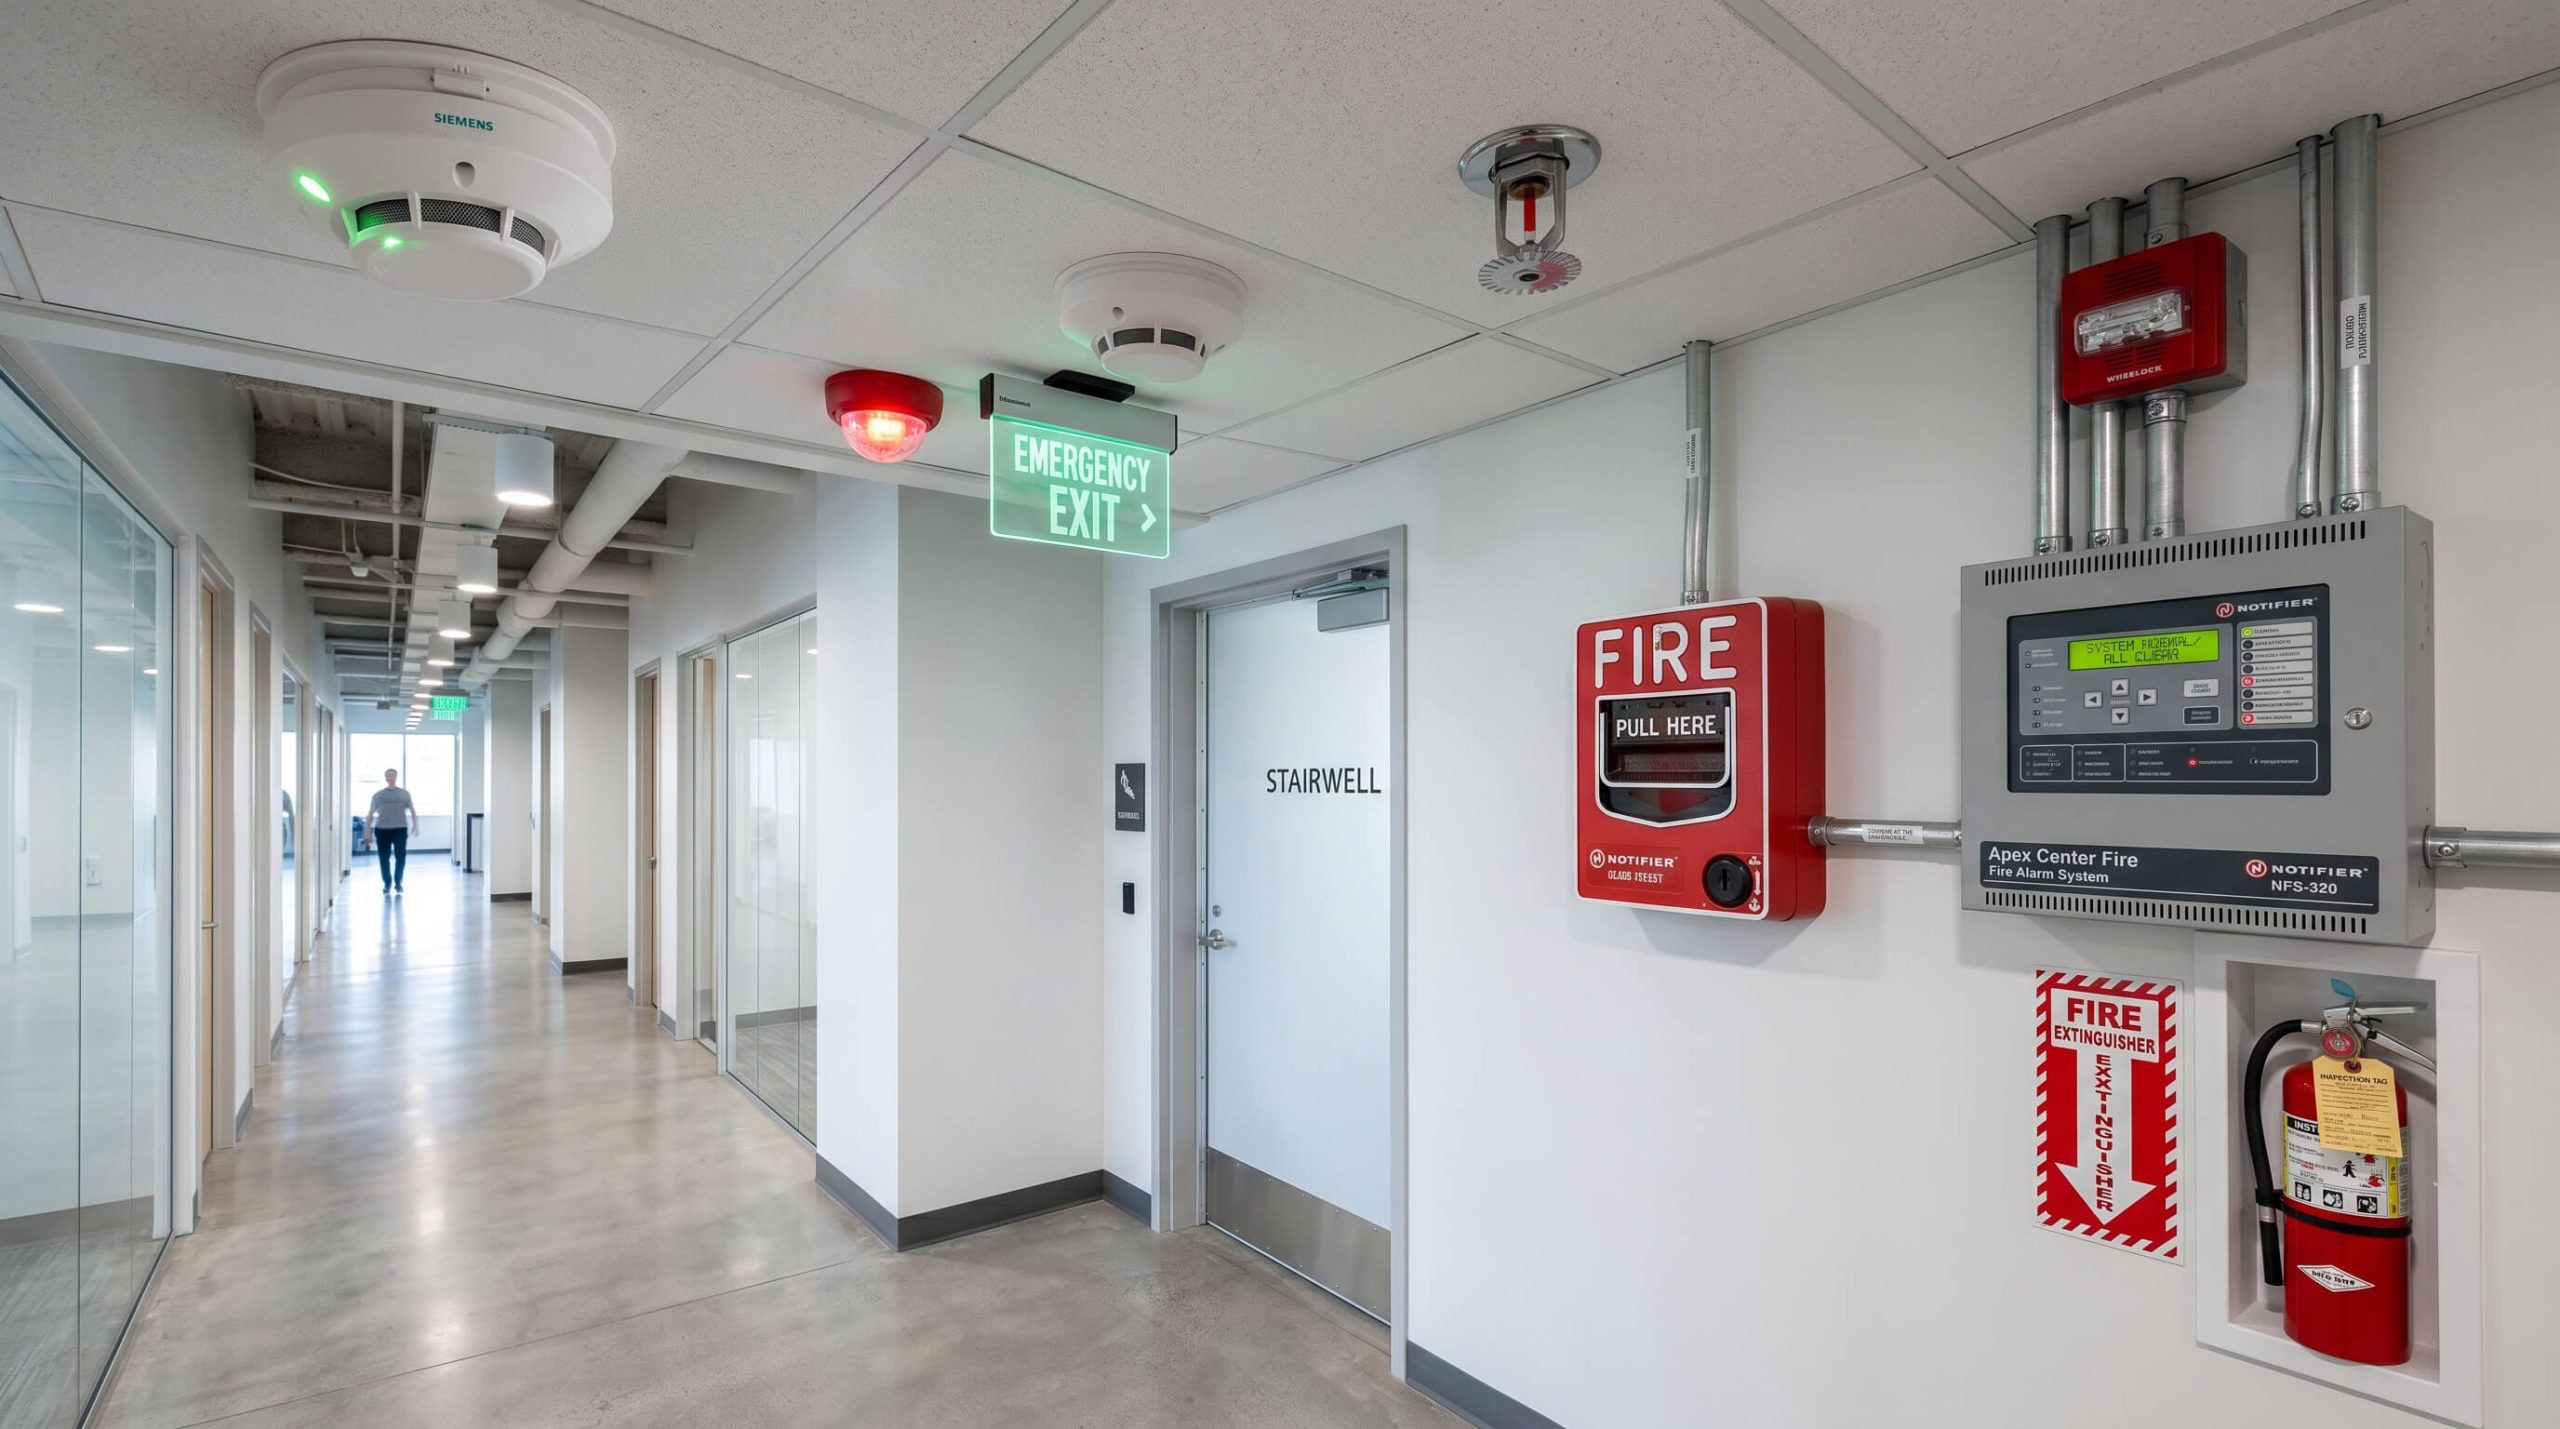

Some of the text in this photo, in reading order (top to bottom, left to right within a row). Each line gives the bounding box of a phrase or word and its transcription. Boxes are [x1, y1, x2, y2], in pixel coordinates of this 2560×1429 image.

[434, 112, 494, 132] SIEMENS
[2106, 365, 2163, 383] WHEELOCK
[1014, 433, 1151, 493] EMERGENCY
[1050, 484, 1121, 542] EXIT
[2237, 598, 2314, 612] NOTIFIER
[1594, 615, 1738, 689] FIRE
[1616, 714, 1717, 738] PULL HERE
[1266, 767, 1382, 794] STAIRWELL
[1607, 854, 1674, 868] NOTIFIER
[1988, 846, 2139, 868] Apex Center Fire
[1989, 865, 2109, 884] Fire Alarm System
[2271, 865, 2363, 879] NOTIFIER
[2271, 880, 2338, 895] NFS-320
[2067, 997, 2142, 1032] FIRE
[2054, 1024, 2156, 1055] EXTINGUISHER
